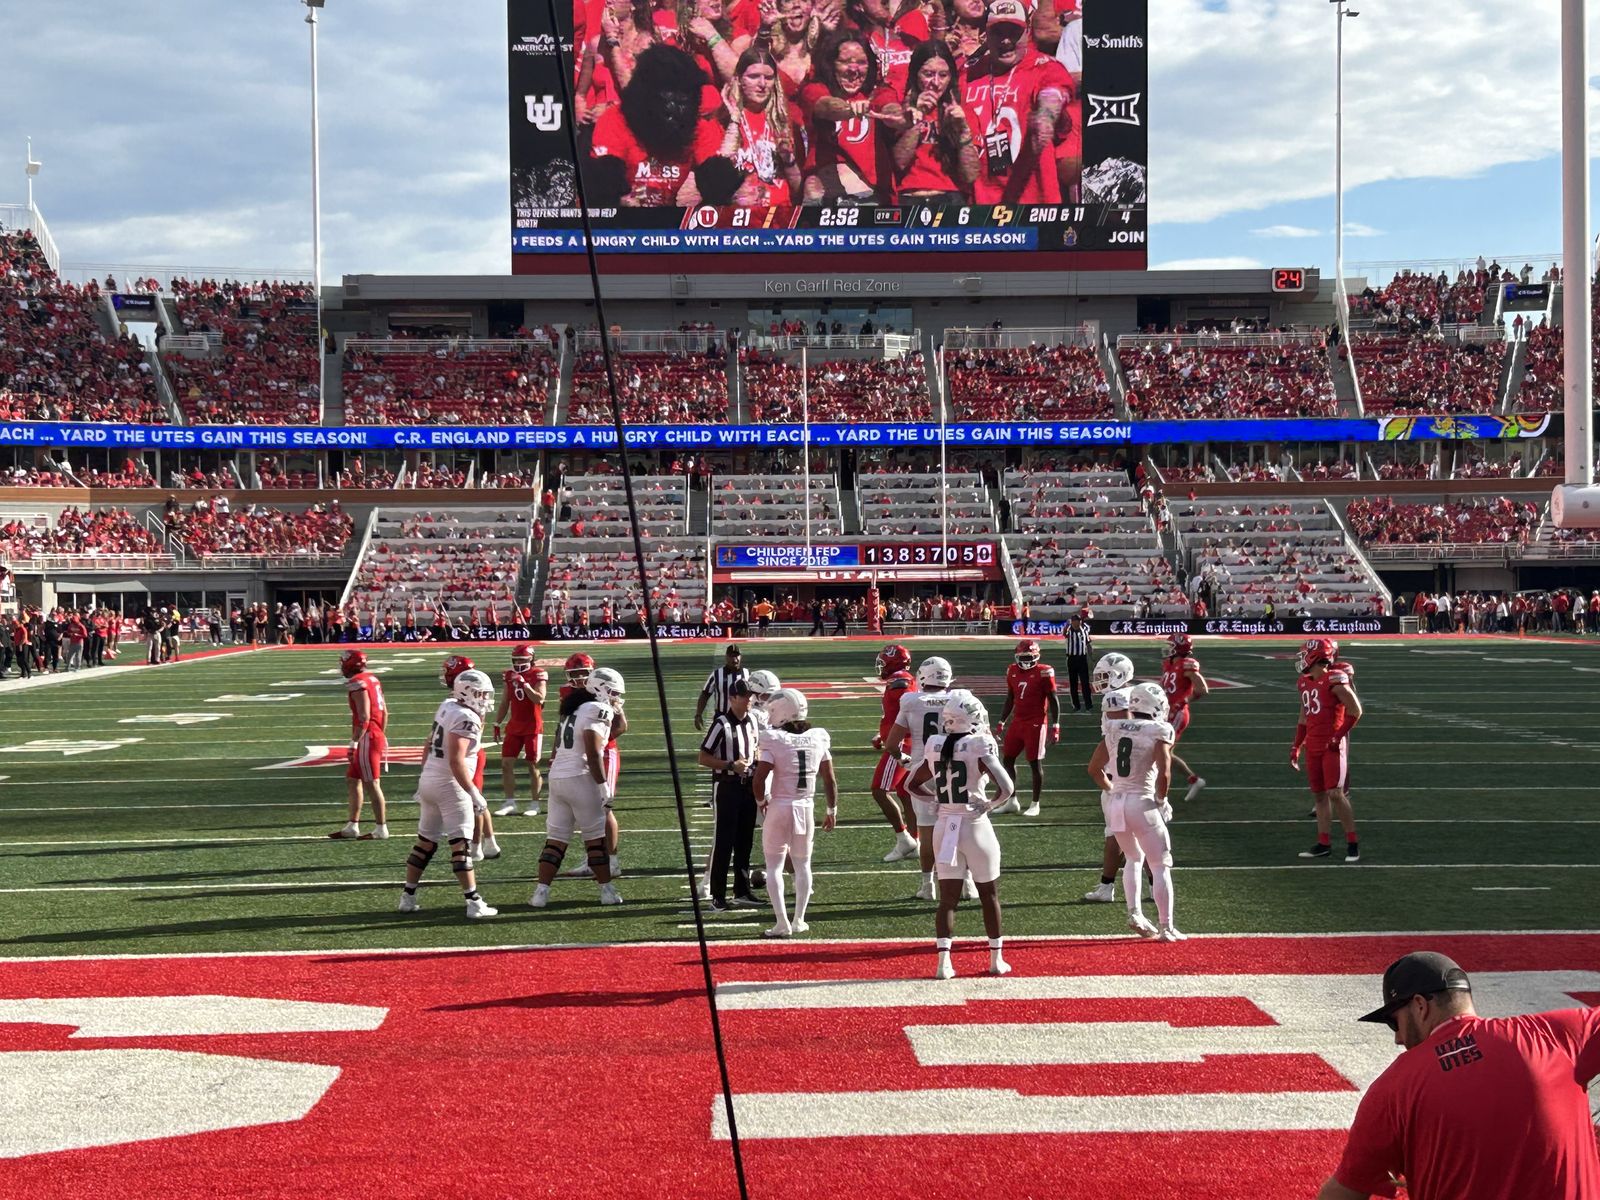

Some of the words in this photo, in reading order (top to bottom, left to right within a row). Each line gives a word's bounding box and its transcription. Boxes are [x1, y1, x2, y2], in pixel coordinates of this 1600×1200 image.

[1102, 34, 1143, 48] Smith's
[635, 162, 680, 178] MSS
[516, 208, 531, 218] THIS
[532, 208, 558, 218] DEFENSE
[586, 208, 600, 218] OUR
[601, 208, 617, 218] HELP
[732, 208, 750, 226] 21
[819, 208, 859, 226] 2:52
[958, 207, 970, 225] 6
[1029, 208, 1057, 222] 2ND
[1060, 208, 1070, 222] &
[1074, 207, 1085, 221] 11
[1121, 211, 1131, 224] 4
[516, 219, 538, 228] NORTH
[521, 236, 563, 246] FEEDS
[568, 236, 578, 246] A
[641, 236, 680, 246] CHILD
[684, 236, 719, 246] WITH
[723, 235, 760, 246] EACH
[819, 235, 844, 246] THE
[850, 235, 885, 246] UTES
[890, 234, 924, 245] GAIN
[929, 234, 960, 245] THIS
[965, 234, 1026, 245] SEASON!
[1108, 231, 1145, 244] JOIN
[765, 279, 791, 292] Ken
[796, 279, 829, 292] Garff
[834, 279, 861, 292] Red
[866, 279, 900, 291] Zone
[1277, 271, 1300, 289] 24
[60, 429, 107, 442] YARD
[113, 430, 145, 442] THE
[152, 431, 195, 443] UTES
[202, 432, 243, 444] GAIN
[249, 432, 287, 444] THIS
[294, 432, 367, 445] SEASON!
[394, 432, 426, 444] C.R.
[431, 432, 510, 444] ENGLAND
[516, 431, 567, 443] FEEDS
[574, 431, 585, 443] A
[665, 430, 712, 443] CHILD
[718, 430, 761, 442] WITH
[767, 430, 810, 442] EACH
[837, 430, 881, 441] YARD
[887, 429, 918, 441] THE
[924, 429, 964, 440] UTES
[972, 428, 1012, 440] GAIN
[1018, 428, 1053, 440] THIS
[1059, 427, 1131, 439] SEASON!
[746, 547, 813, 557] CHILDREN
[816, 547, 840, 556] FED
[757, 557, 797, 566] SINCE
[800, 556, 829, 566] 2018
[1017, 681, 1028, 700] 7
[1302, 688, 1321, 715] 93
[1116, 736, 1133, 778] 8
[796, 749, 808, 789] 1
[933, 760, 969, 804] 22
[1434, 1033, 1477, 1058] UTAH
[1438, 1046, 1485, 1072] UTES
